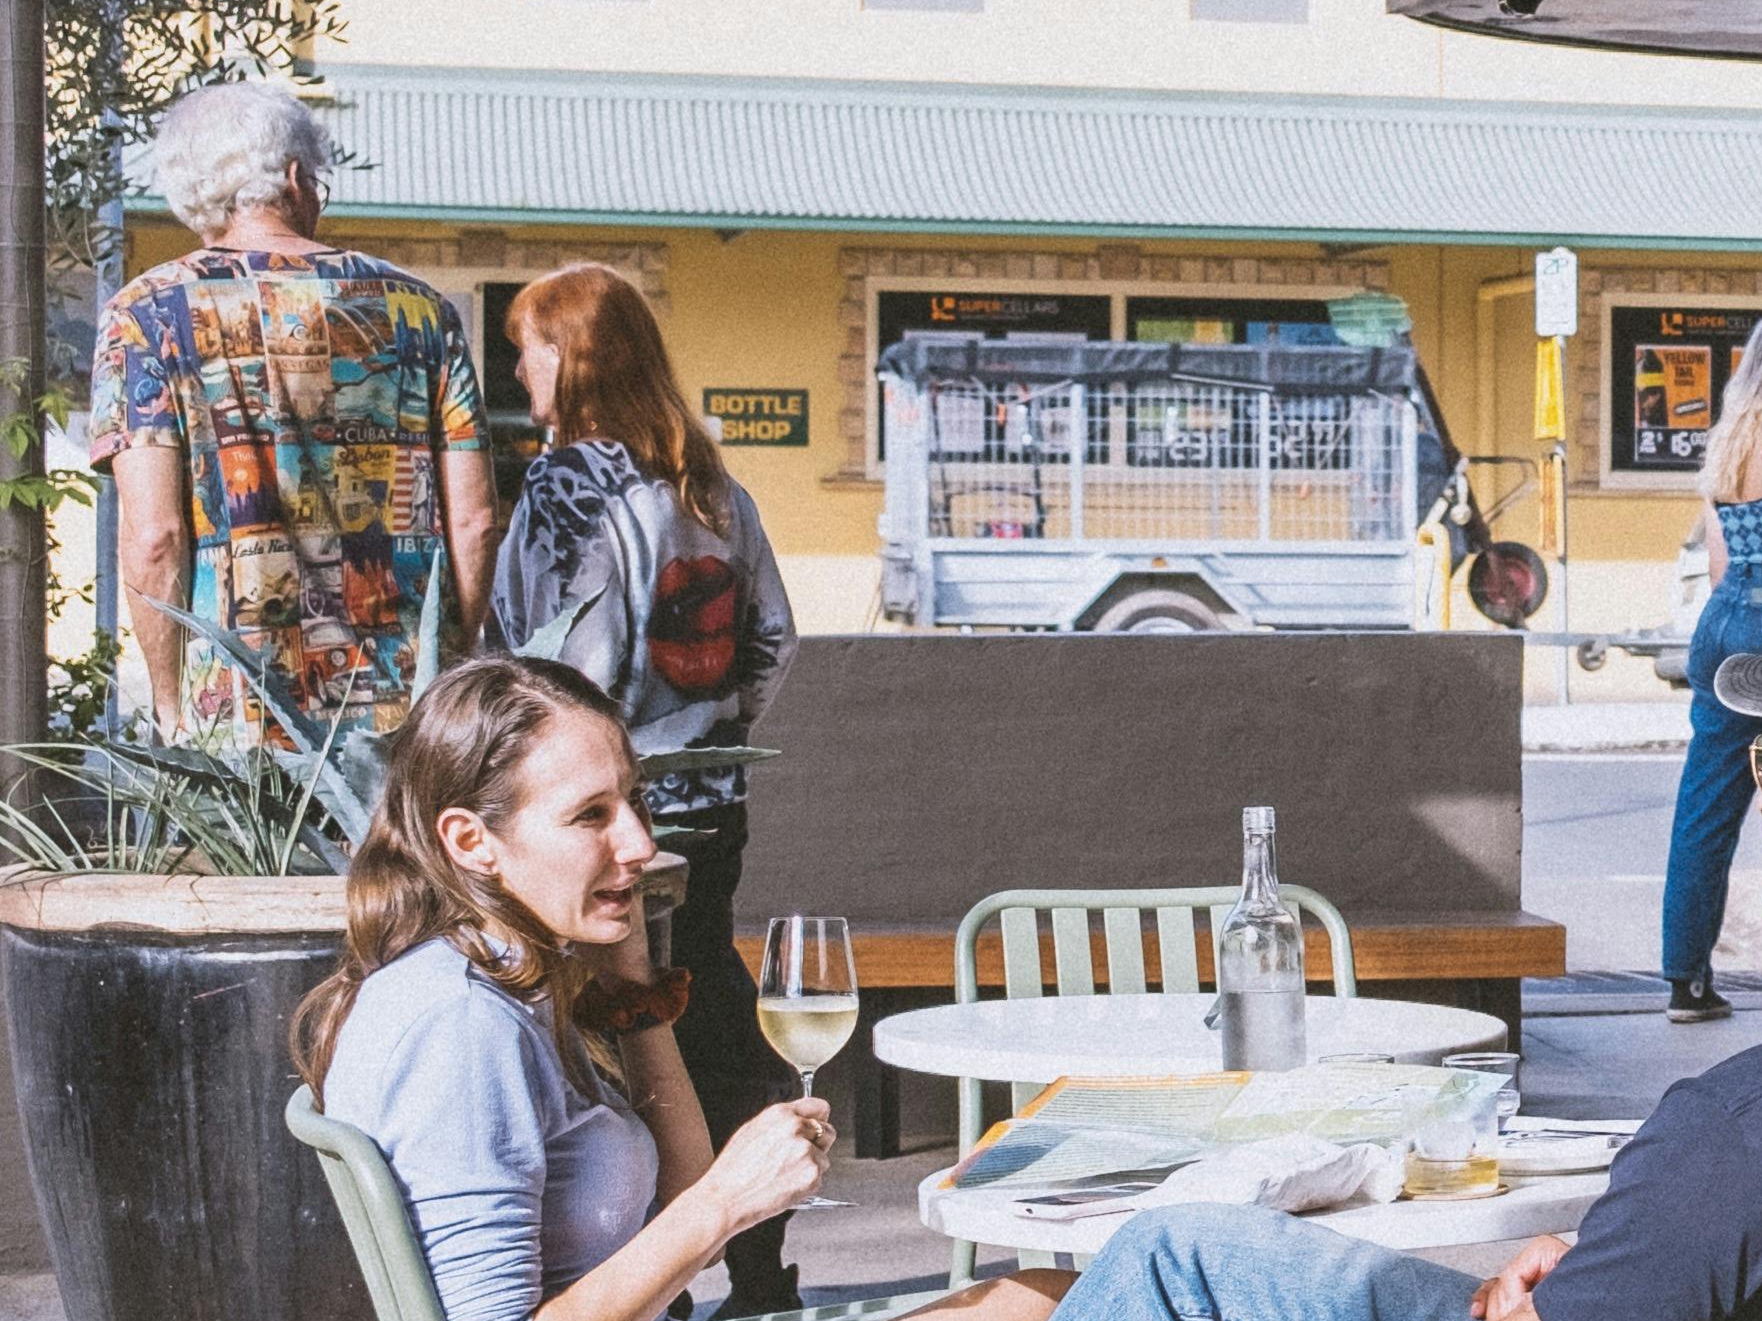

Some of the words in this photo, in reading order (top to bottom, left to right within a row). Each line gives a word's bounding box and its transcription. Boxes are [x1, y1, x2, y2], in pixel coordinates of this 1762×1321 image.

[710, 395, 801, 415] BOTTLE
[345, 428, 388, 443] CUBA
[723, 419, 791, 440] SHOP
[396, 537, 446, 554] IBIZA
